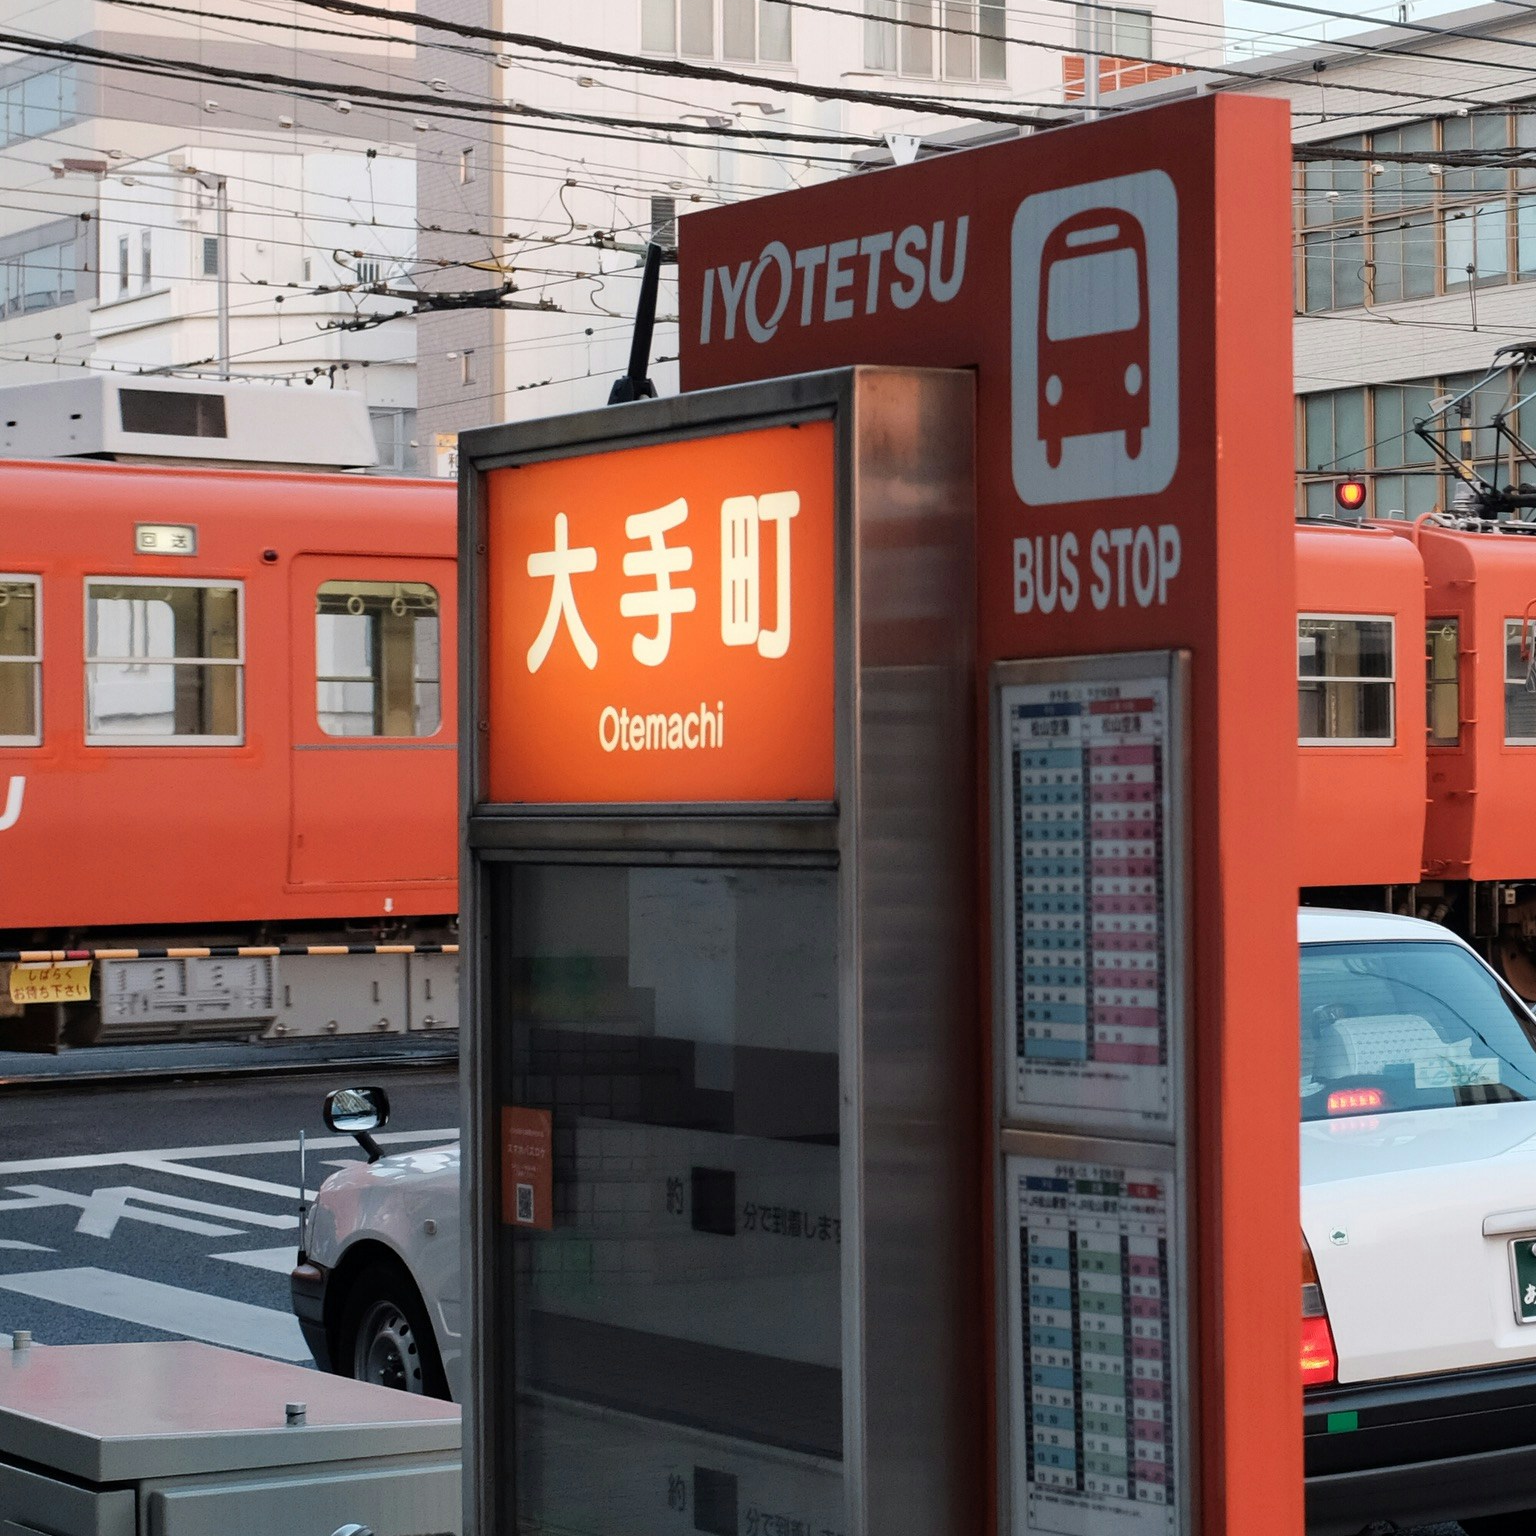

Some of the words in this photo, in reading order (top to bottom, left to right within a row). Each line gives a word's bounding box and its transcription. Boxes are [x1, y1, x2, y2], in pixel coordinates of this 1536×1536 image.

[699, 215, 970, 345] IYOTETSU
[526, 490, 800, 674] 大手町
[1013, 531, 1079, 614] BUS
[1090, 524, 1181, 610] STOP
[598, 700, 724, 752] Otemachi
